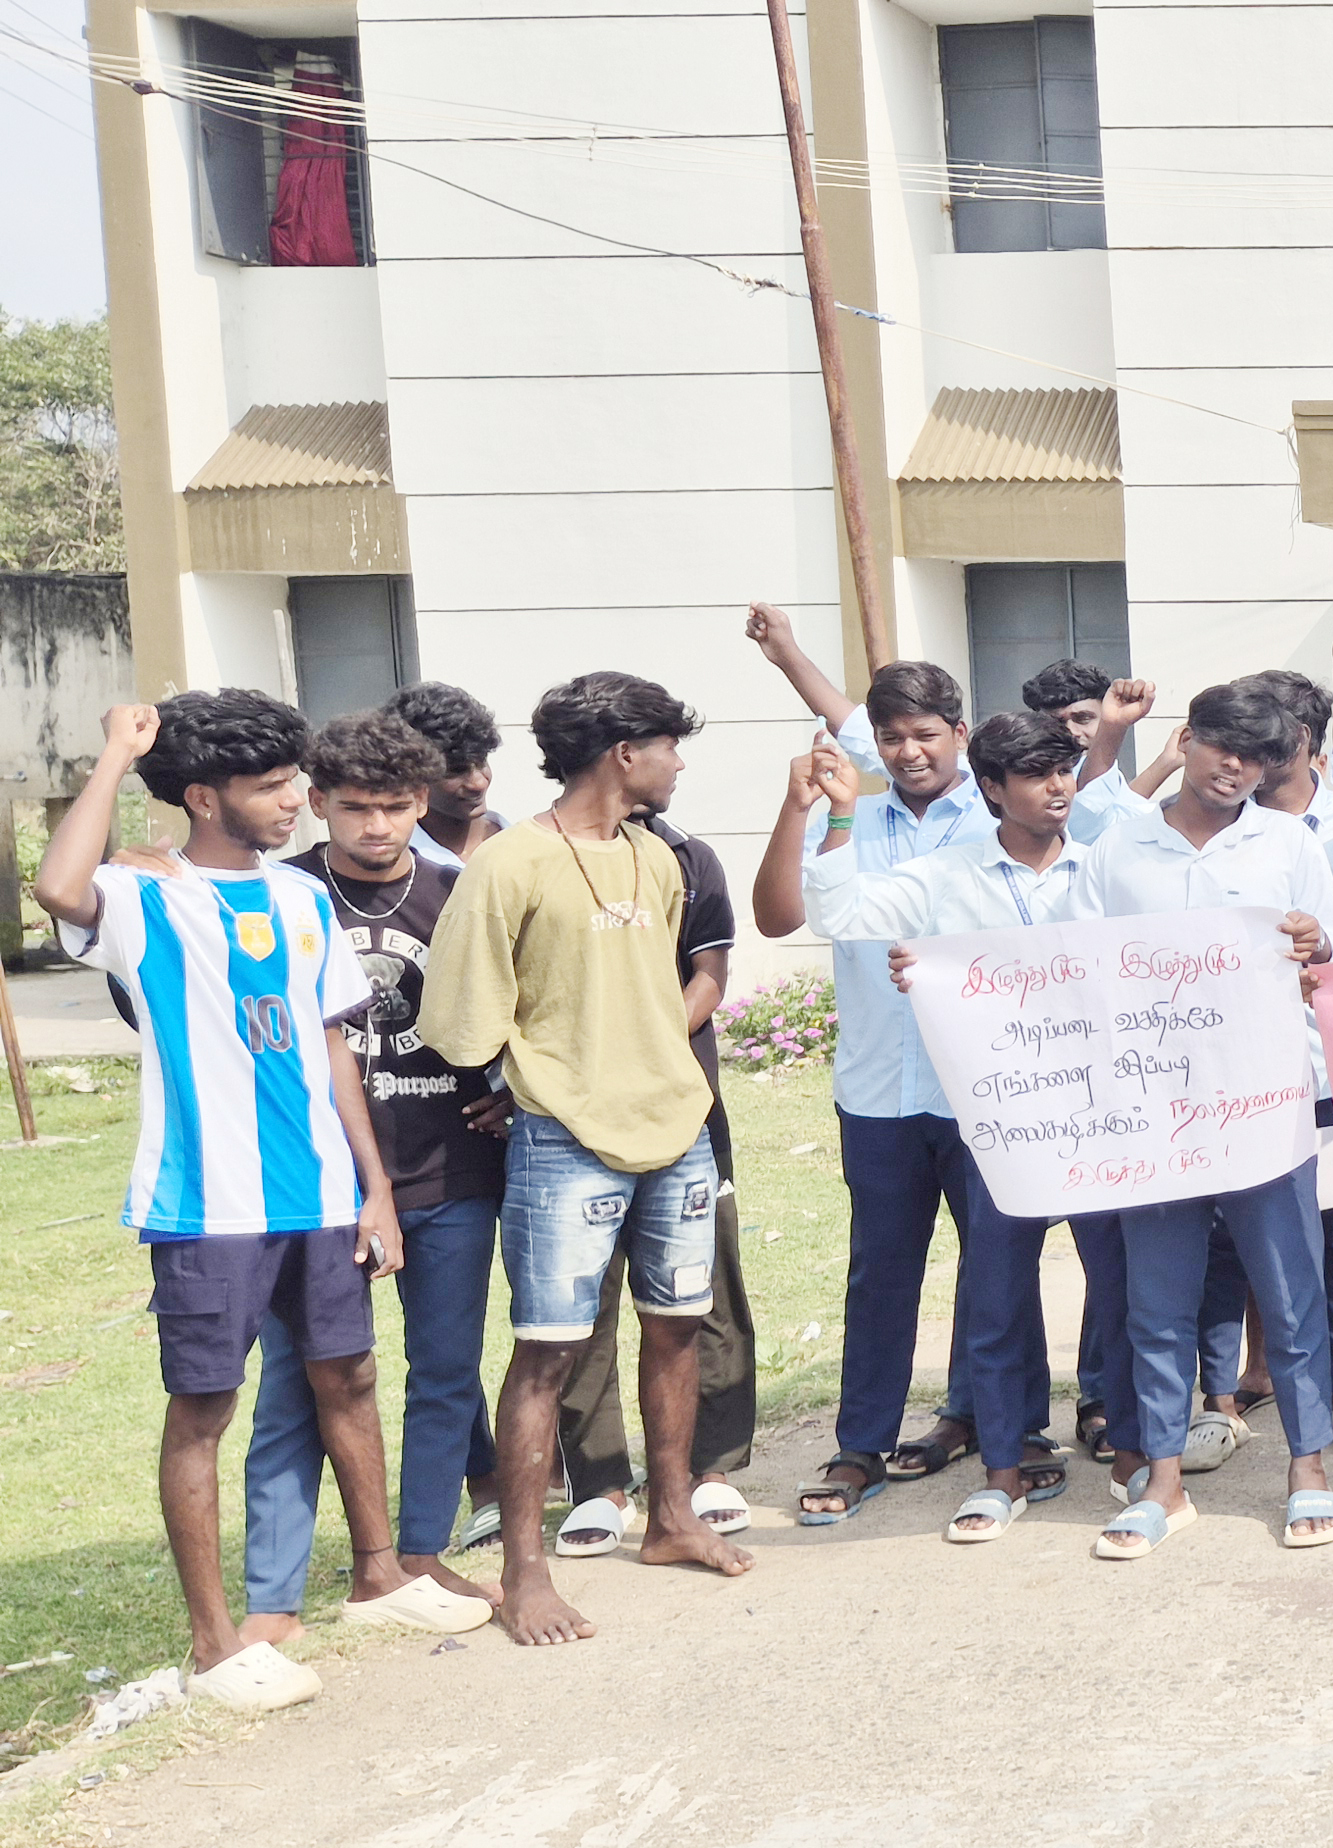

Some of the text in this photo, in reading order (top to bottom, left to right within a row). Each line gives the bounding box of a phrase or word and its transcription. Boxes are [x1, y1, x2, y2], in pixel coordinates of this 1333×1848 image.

[241, 994, 292, 1054] 10
[991, 1002, 1223, 1057] அடிப்படை வசதிக்கே
[372, 1071, 458, 1101] Purpose
[972, 1049, 1189, 1107] எங்களை இப்படி
[1170, 1081, 1310, 1143] நலத்துறையை
